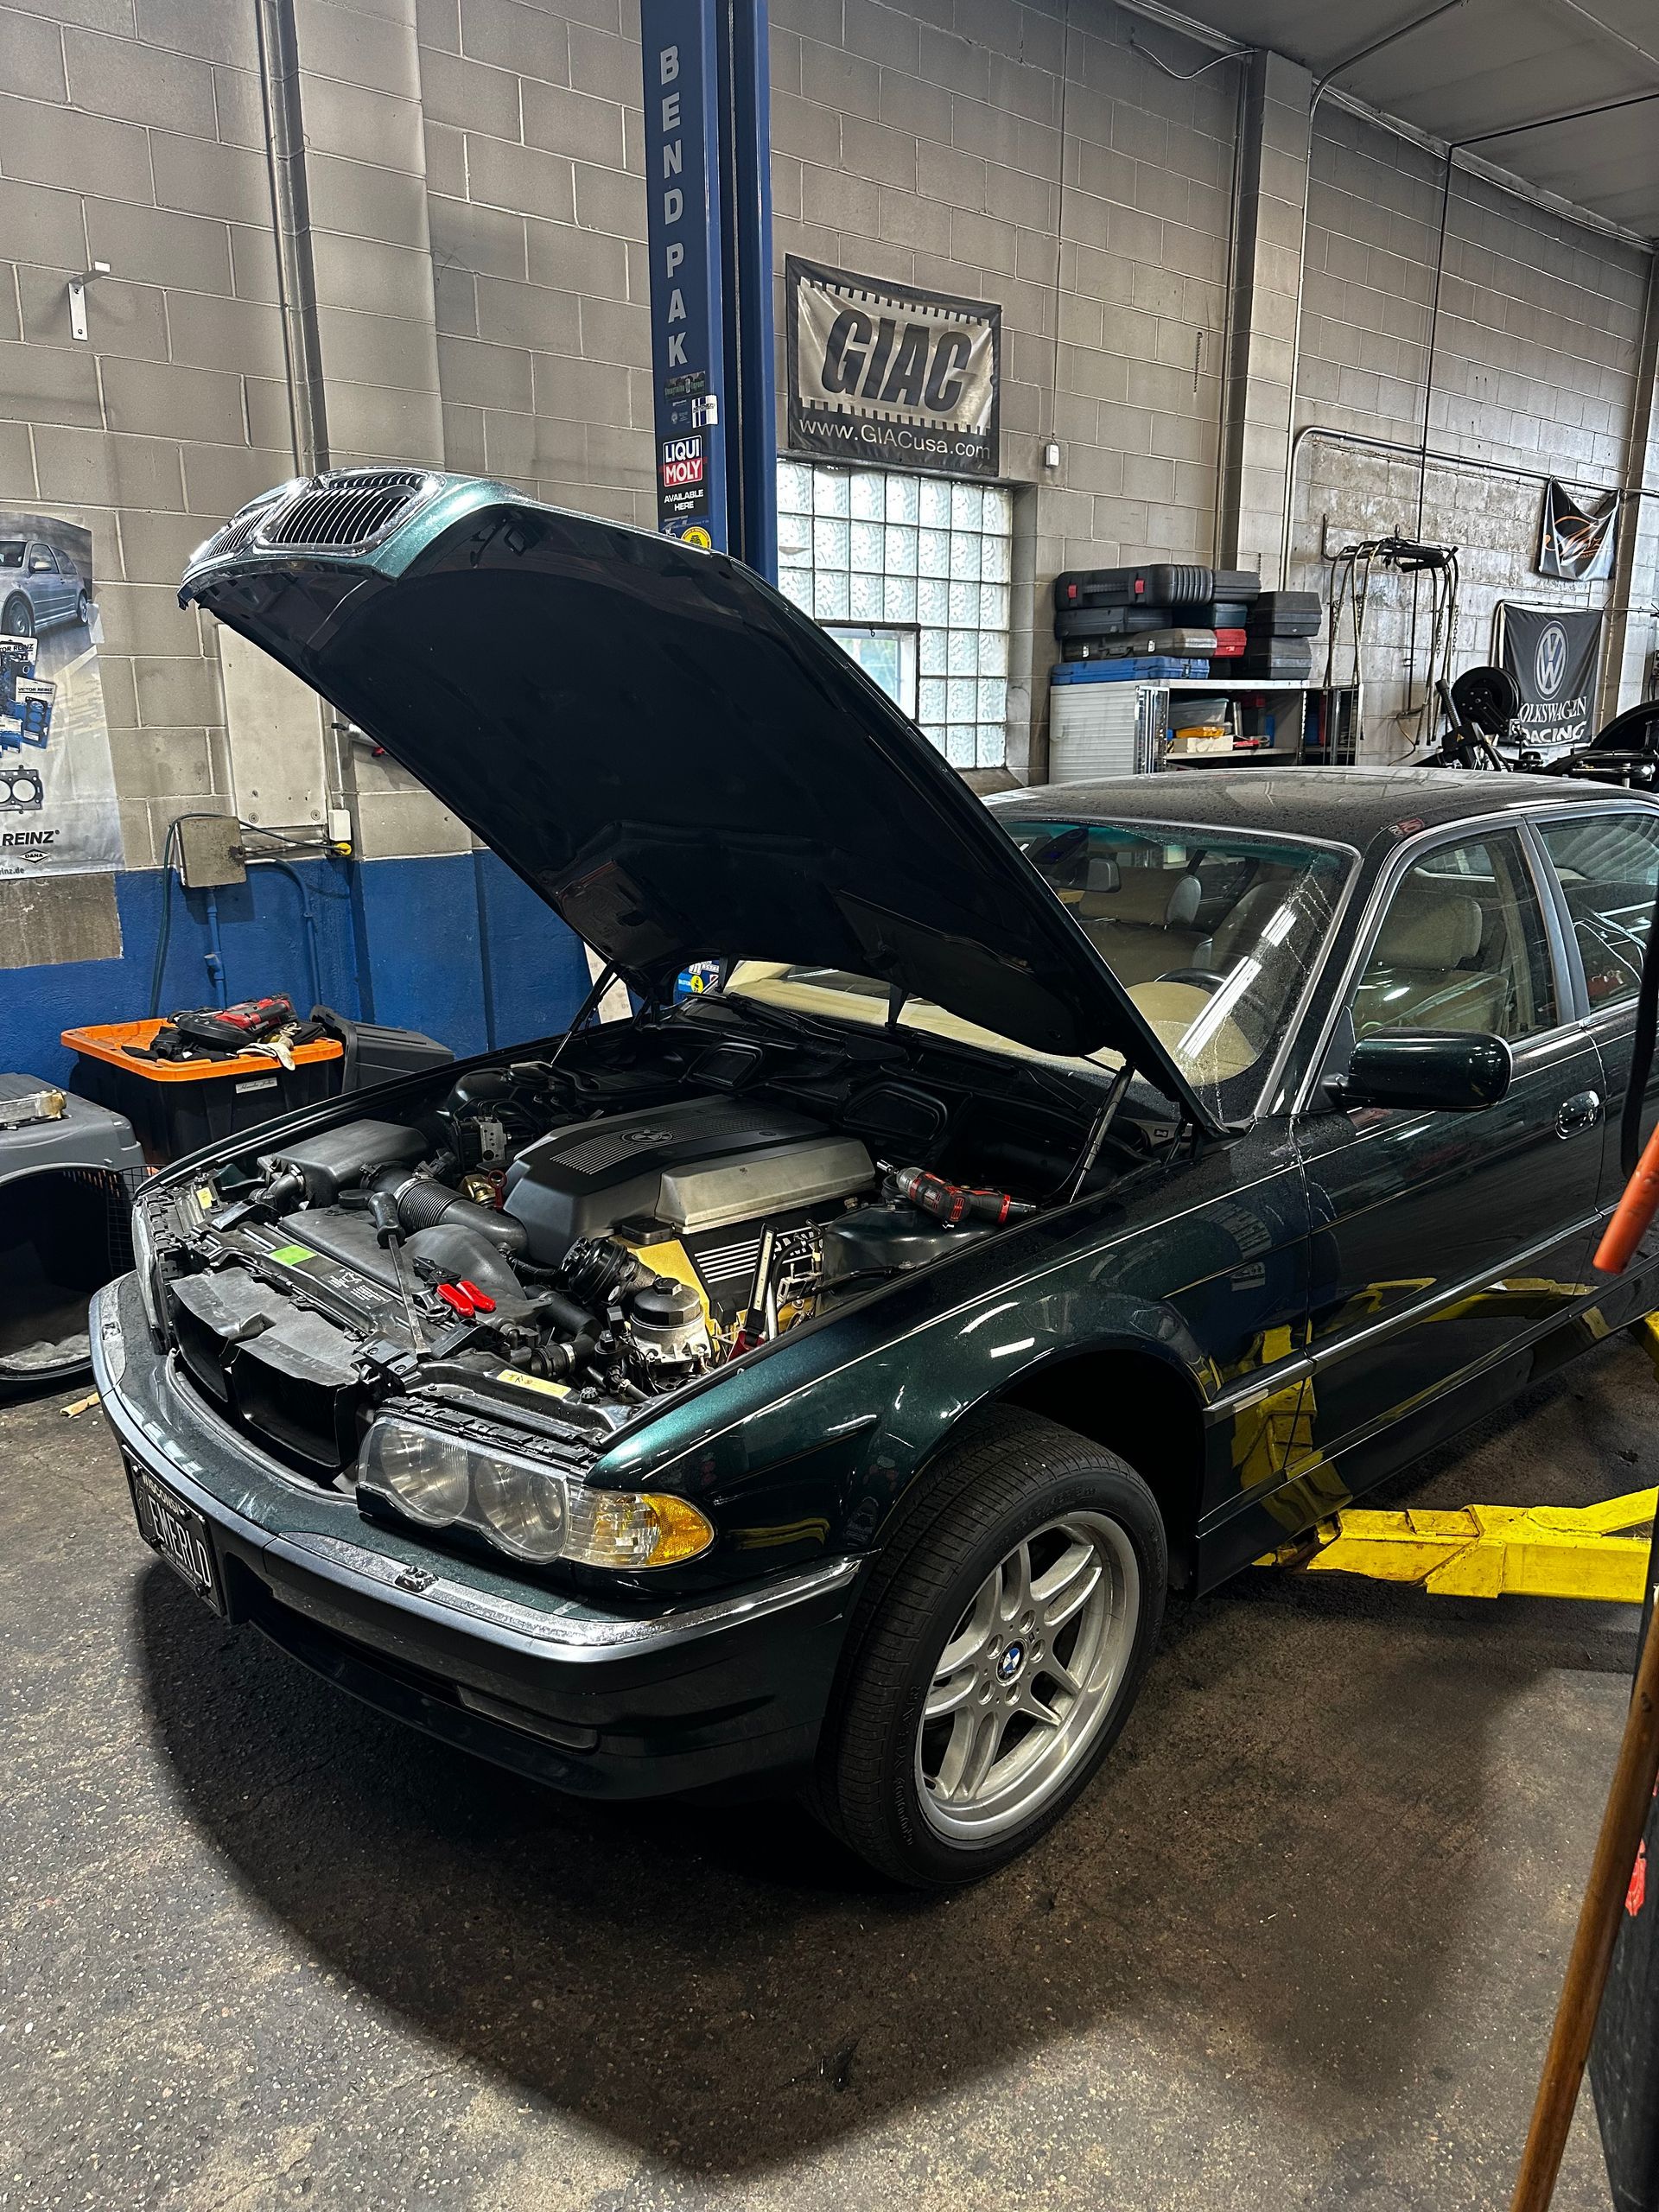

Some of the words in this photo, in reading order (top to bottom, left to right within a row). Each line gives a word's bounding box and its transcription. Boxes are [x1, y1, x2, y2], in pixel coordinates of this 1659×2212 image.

[821, 308, 972, 412] GIAC
[664, 438, 700, 463] LIQUI
[798, 419, 991, 460] www.GIACusa.com
[665, 460, 701, 484] MOLY
[664, 489, 704, 504] AVAILABLE
[674, 500, 694, 512] HERE
[1518, 696, 1587, 723] OLKSWAGEN
[2, 830, 54, 846] REINZ
[148, 1494, 213, 1588] EMERLD
